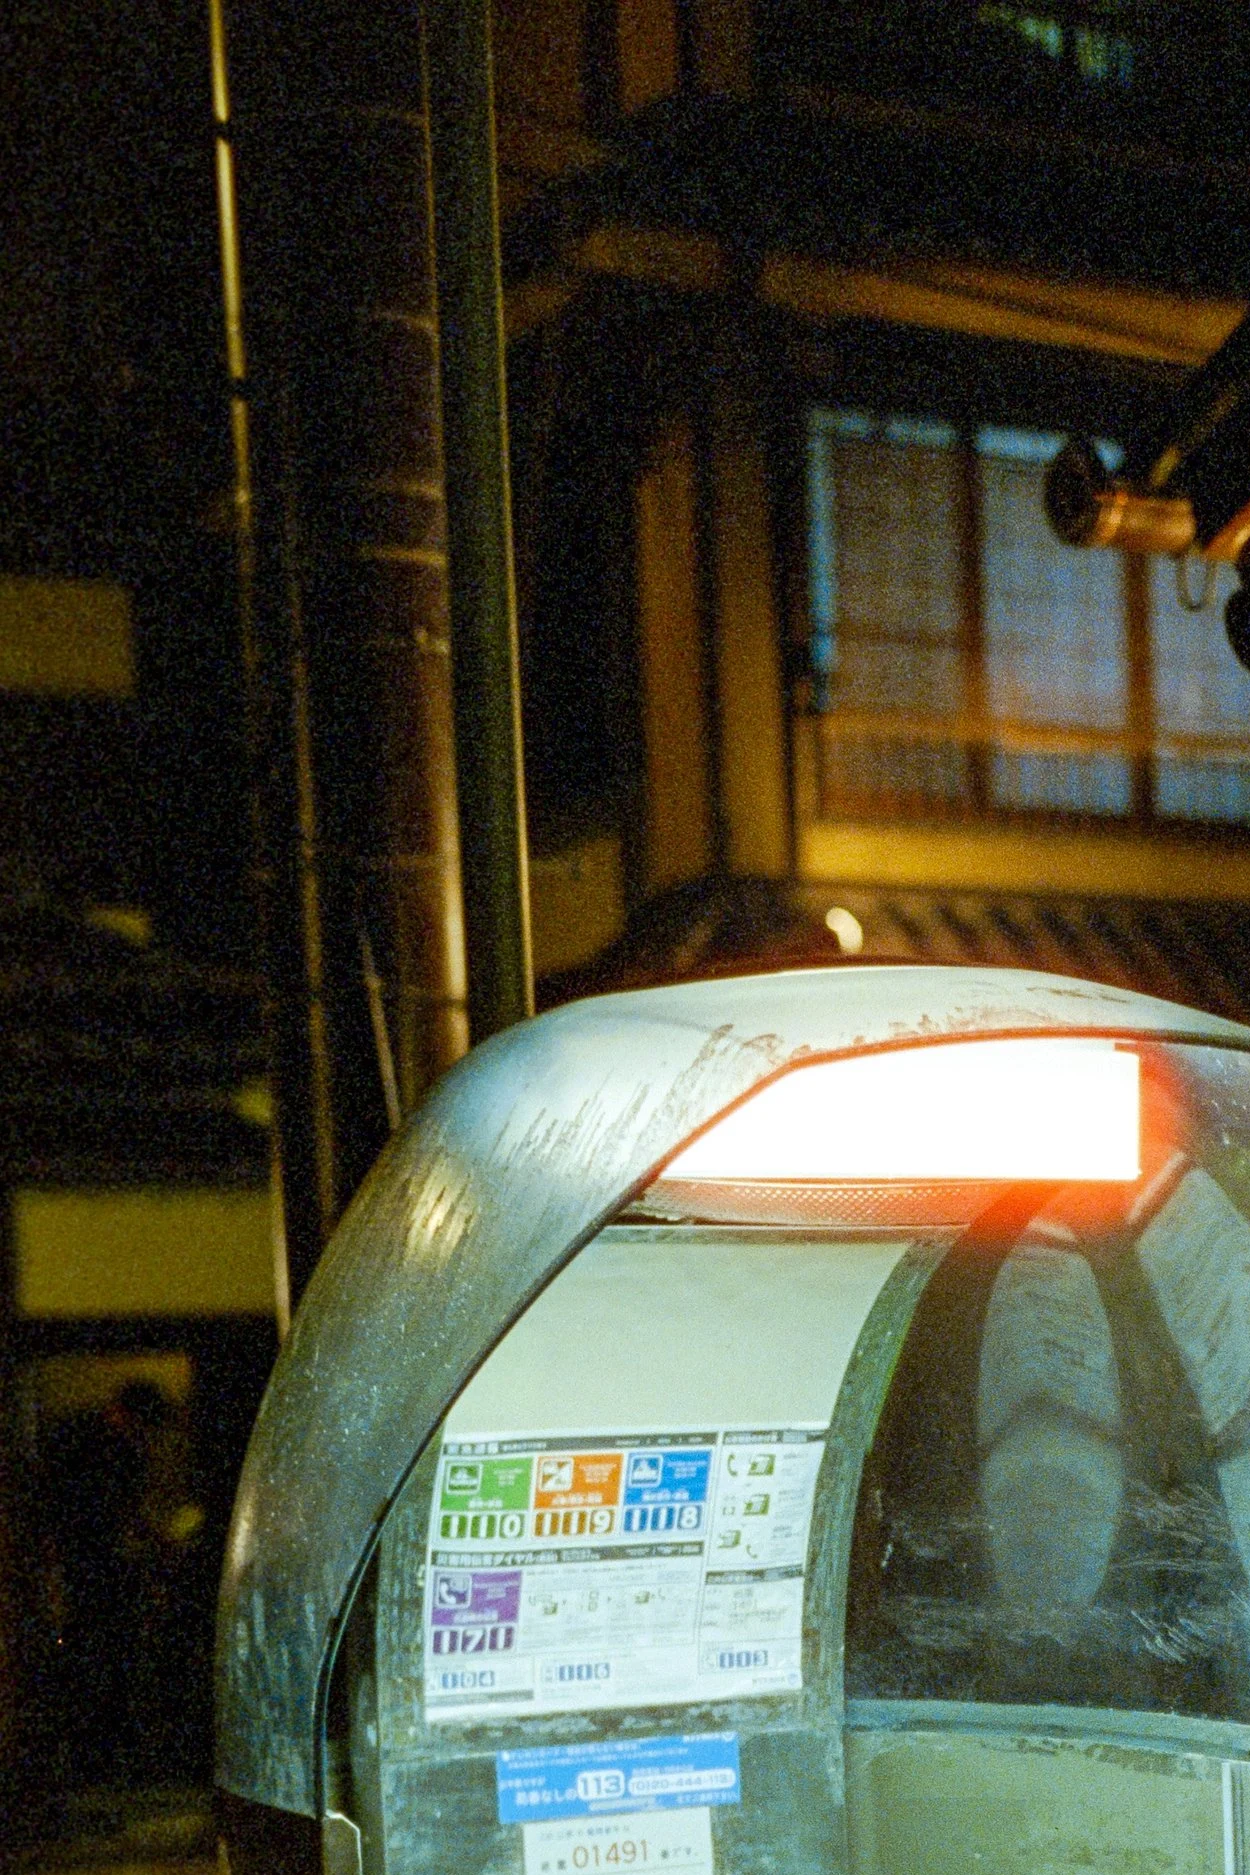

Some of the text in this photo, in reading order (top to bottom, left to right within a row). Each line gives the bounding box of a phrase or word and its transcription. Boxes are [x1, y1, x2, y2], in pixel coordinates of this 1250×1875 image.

[450, 1506, 698, 1538] 110 119 118
[442, 1626, 506, 1654] 171
[581, 1774, 620, 1797] 113
[572, 1839, 647, 1869] 01491
